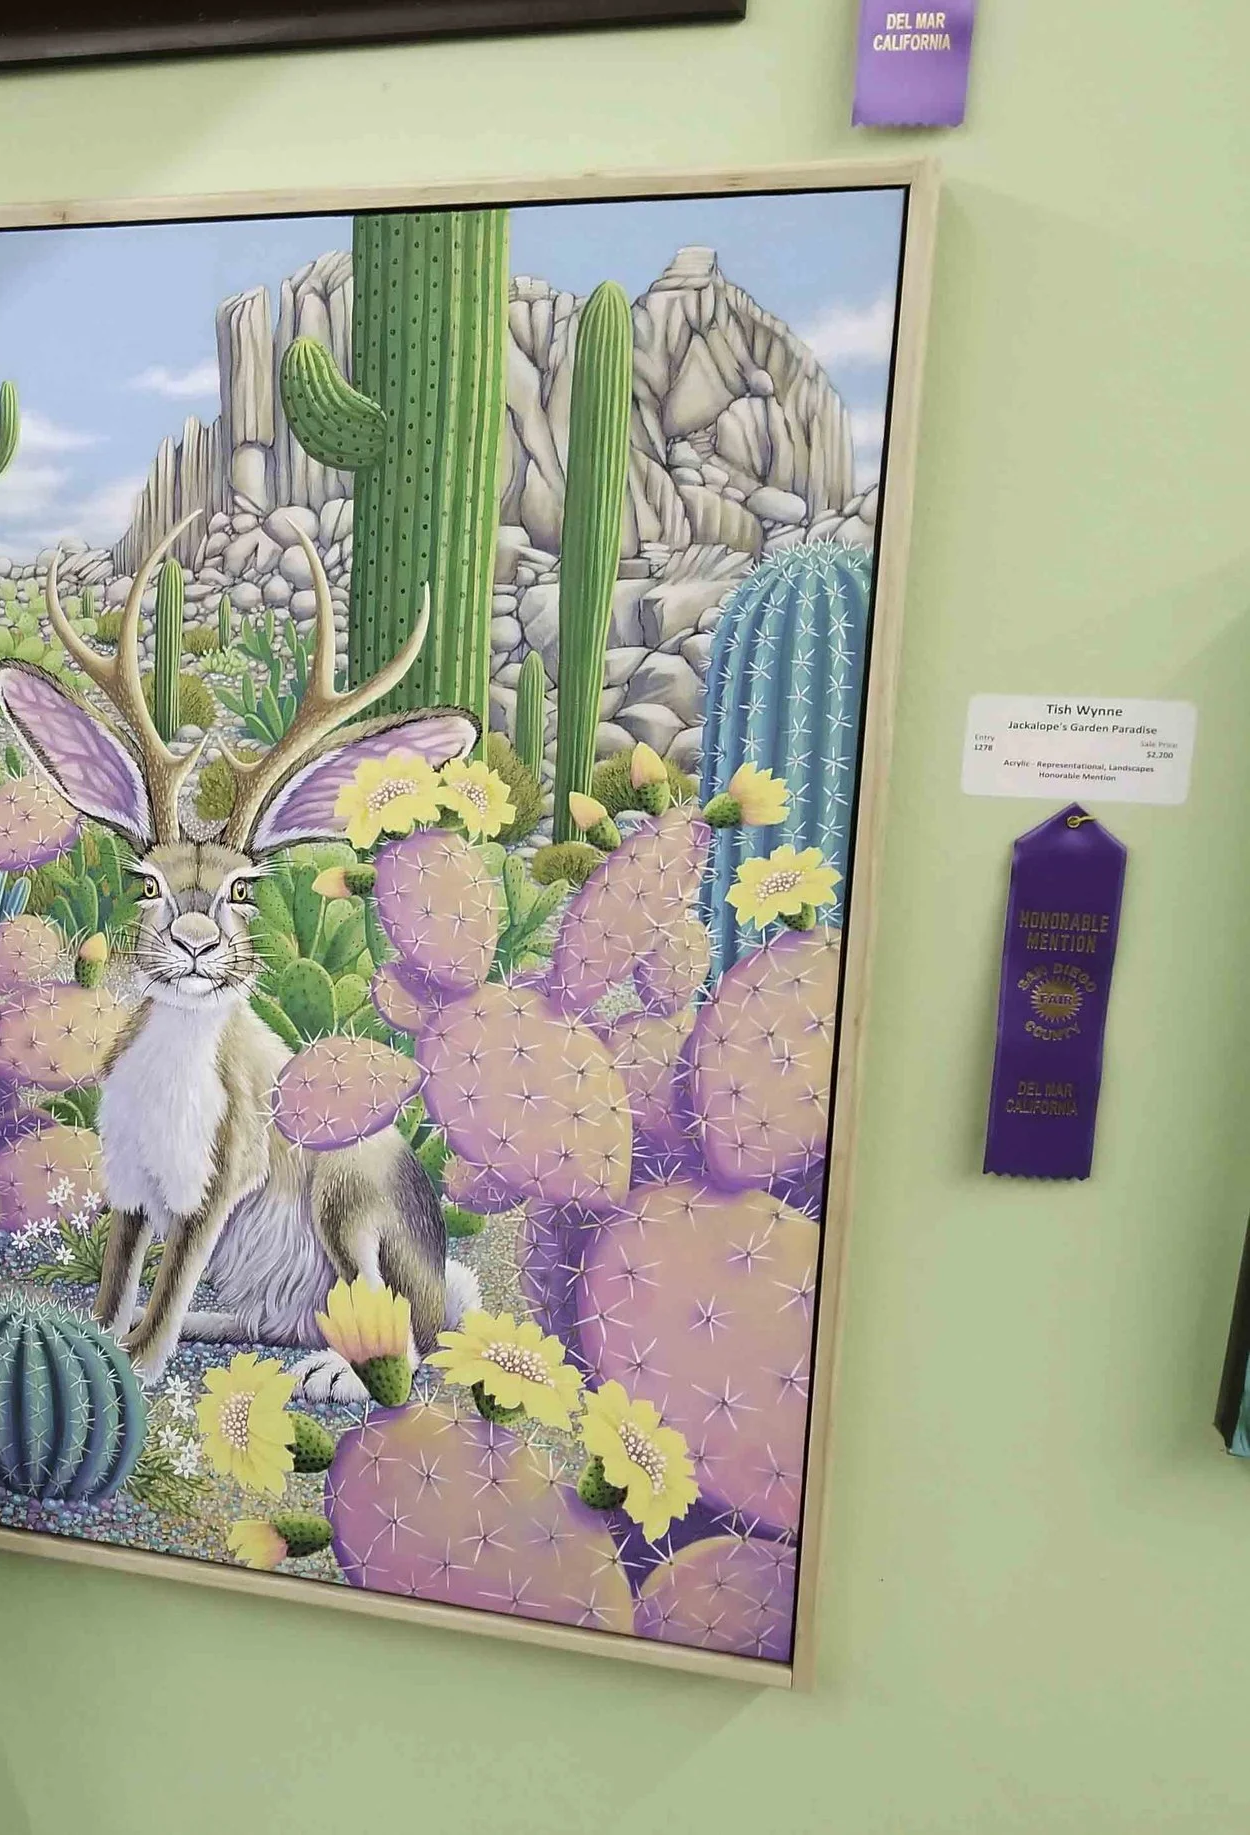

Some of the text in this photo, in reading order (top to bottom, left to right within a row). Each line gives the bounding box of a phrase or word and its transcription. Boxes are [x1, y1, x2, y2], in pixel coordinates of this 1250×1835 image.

[886, 12, 946, 30] DEL MAR
[873, 33, 951, 51] CALIFORNIA
[1046, 704, 1123, 718] Tish Wynne
[1008, 721, 1158, 735] Jackalope's Garden Paradise
[974, 734, 995, 742] Entry
[1003, 759, 1030, 768] Acrylic
[1109, 763, 1154, 773] Landscapes
[1039, 771, 1116, 781] Honorable Mention
[1018, 909, 1110, 933] HONORABLE
[1026, 931, 1097, 953] MENTION
[1017, 963, 1096, 992] SAN DIEGO
[1039, 993, 1074, 1006] FAIR
[1024, 1020, 1081, 1041] COUNTY
[1017, 1080, 1073, 1098] DEL MAR
[1006, 1098, 1078, 1117] CALIFORNIA
